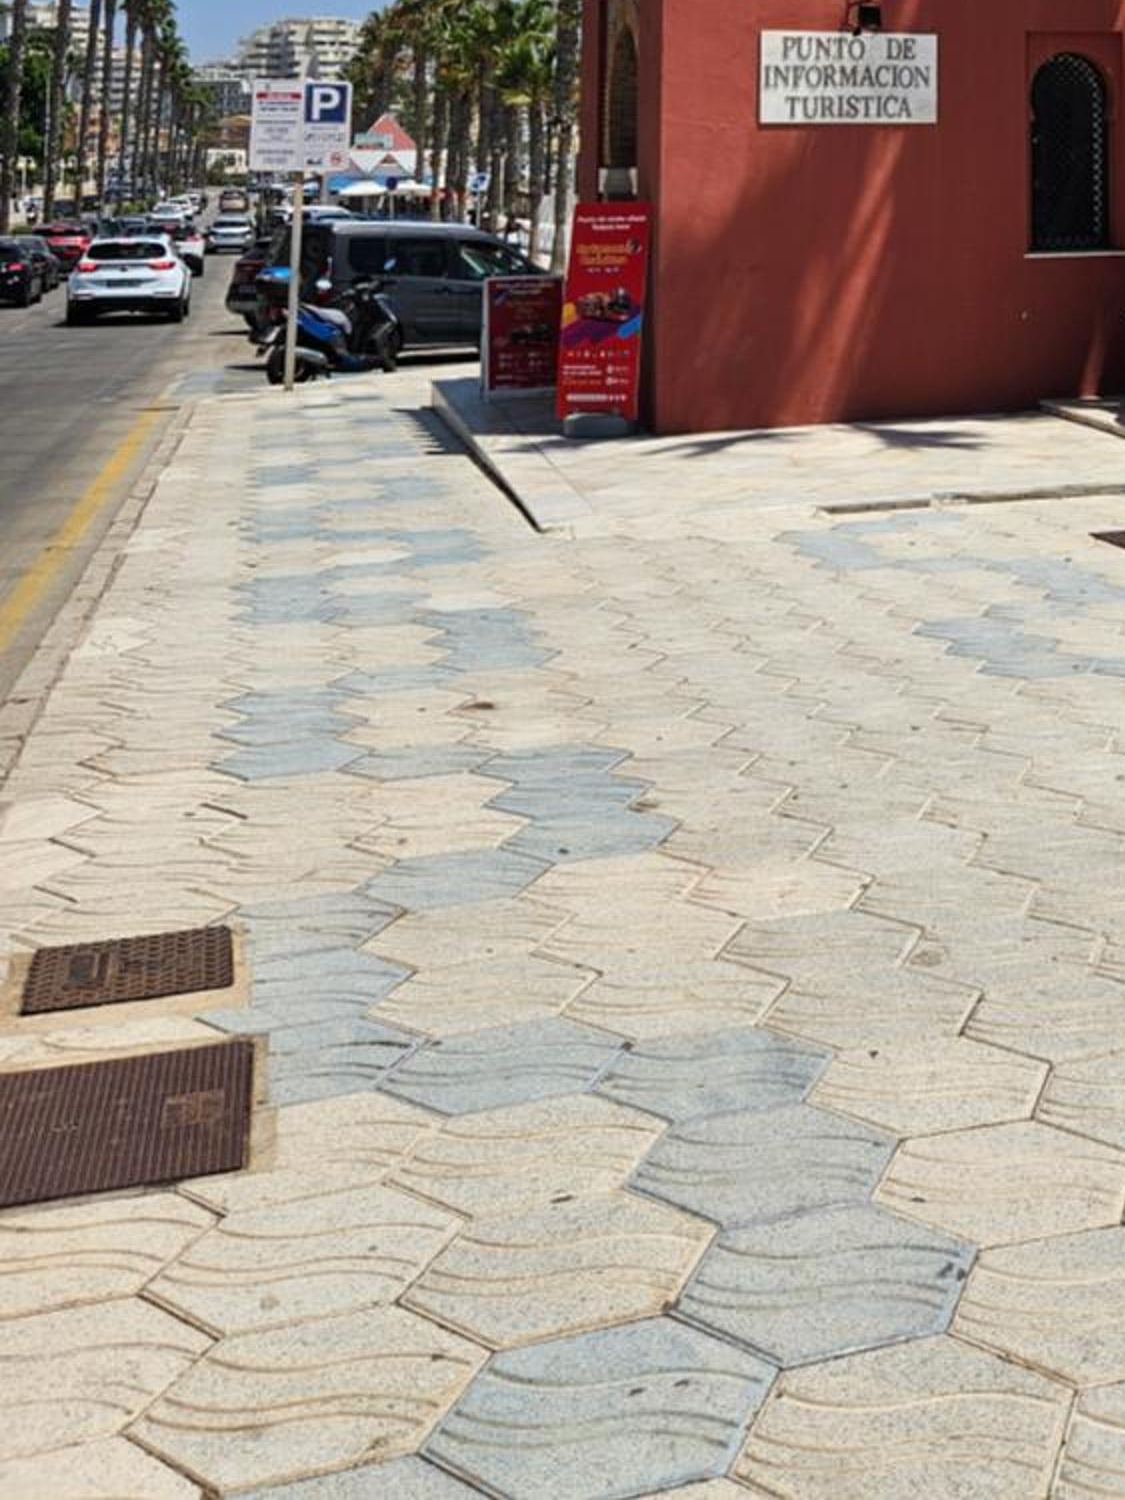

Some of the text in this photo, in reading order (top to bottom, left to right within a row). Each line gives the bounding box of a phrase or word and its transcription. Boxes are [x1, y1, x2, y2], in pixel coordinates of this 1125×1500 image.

[782, 36, 916, 61] PUNTO DE
[764, 65, 931, 88] INFORMACION
[311, 87, 341, 121] P
[785, 95, 912, 120] TURISTICA
